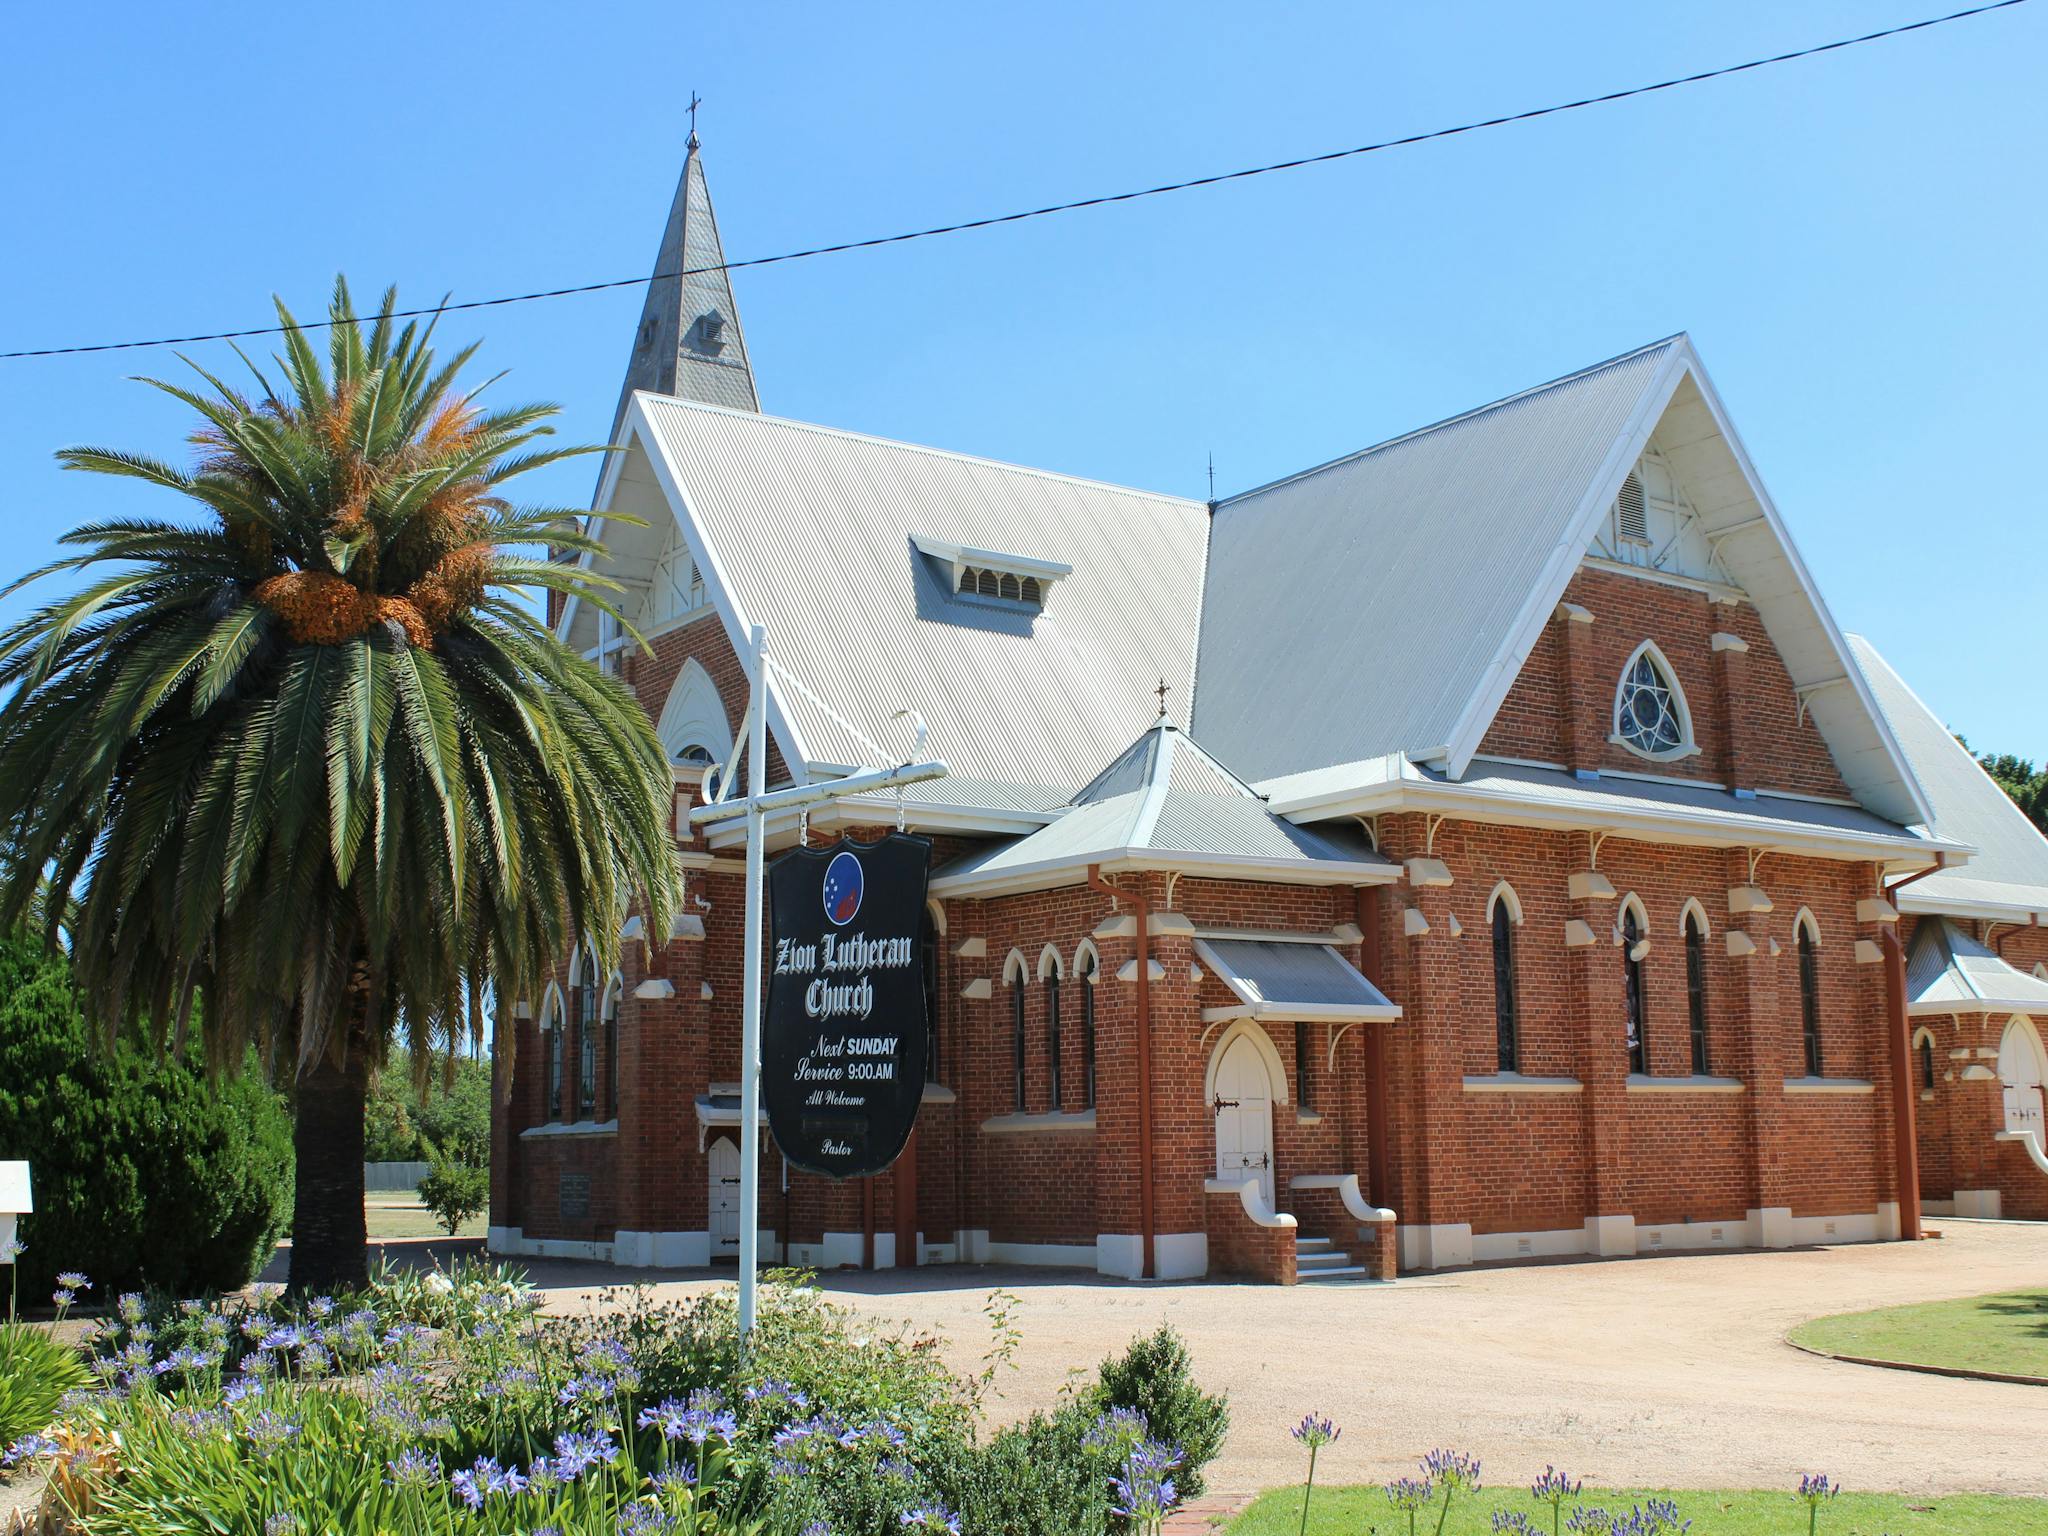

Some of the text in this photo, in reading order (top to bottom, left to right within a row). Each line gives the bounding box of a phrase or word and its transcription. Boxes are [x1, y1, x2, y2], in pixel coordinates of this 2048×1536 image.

[775, 931, 912, 976] Zion Lutheran
[805, 976, 873, 1021] Church
[810, 1034, 898, 1058] Next SUNDAY
[794, 1057, 843, 1081] Service
[805, 1090, 865, 1106] All Welcome
[821, 1138, 852, 1156] Pastor
